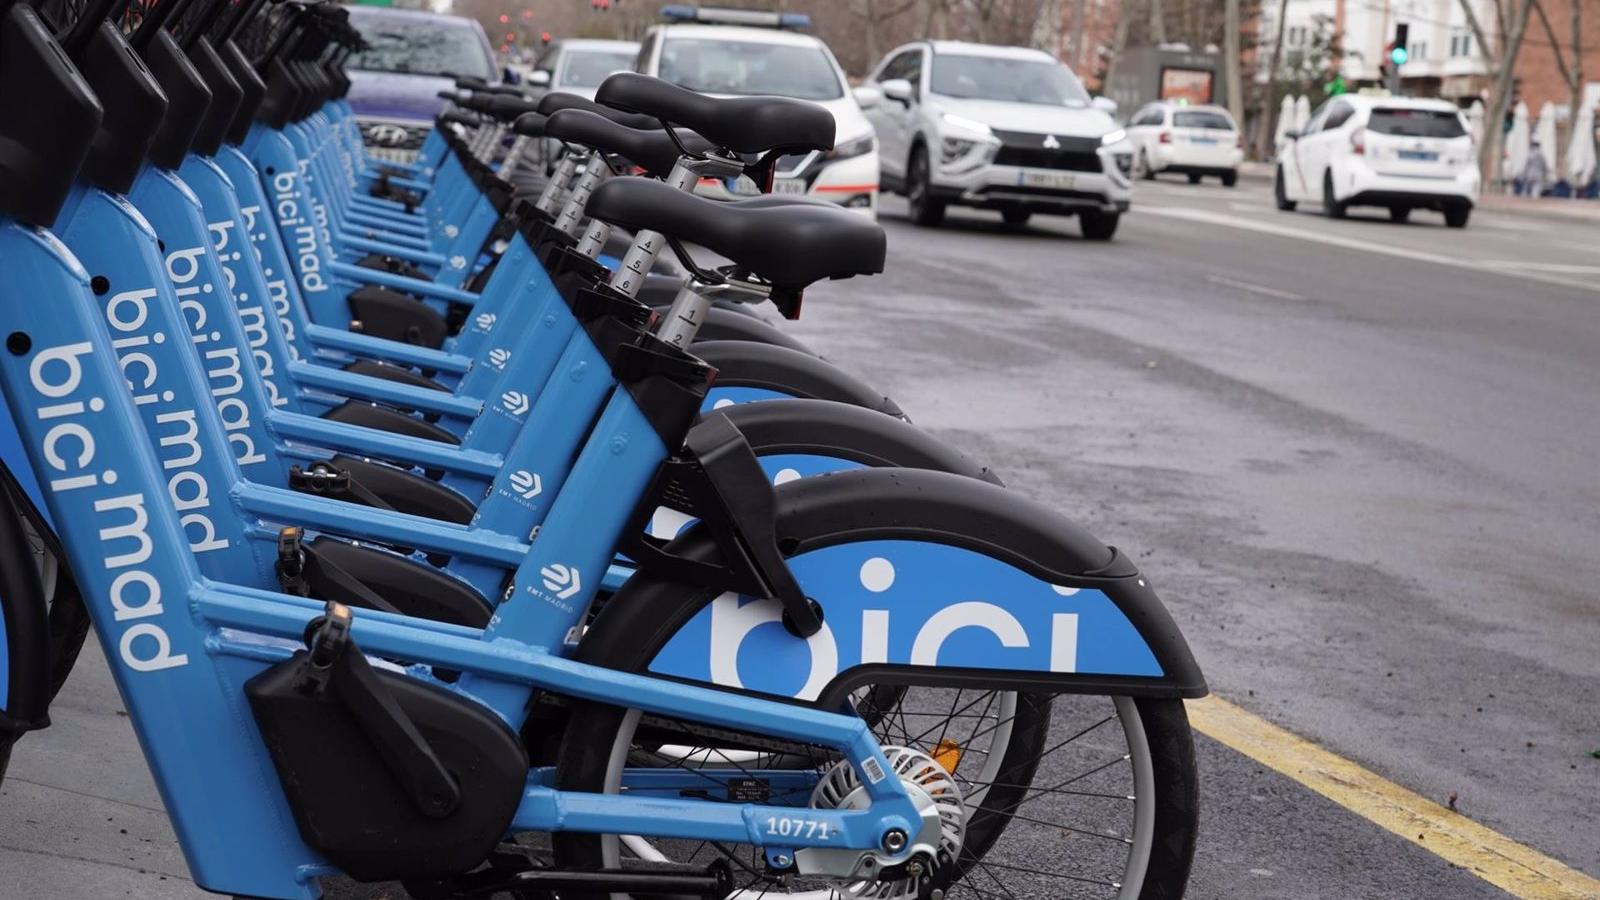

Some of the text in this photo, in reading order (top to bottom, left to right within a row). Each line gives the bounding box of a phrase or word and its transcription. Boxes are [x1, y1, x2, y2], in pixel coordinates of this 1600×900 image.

[241, 205, 273, 277] bi
[274, 172, 328, 292] bici mad
[644, 241, 652, 250] 4
[633, 260, 641, 269] 5
[622, 280, 631, 289] 6
[688, 310, 696, 320] 1
[673, 334, 683, 345] 2
[165, 247, 267, 465] bici mad
[106, 288, 230, 552] bici mad
[29, 341, 189, 672] bici mad
[767, 817, 829, 840] 10771
